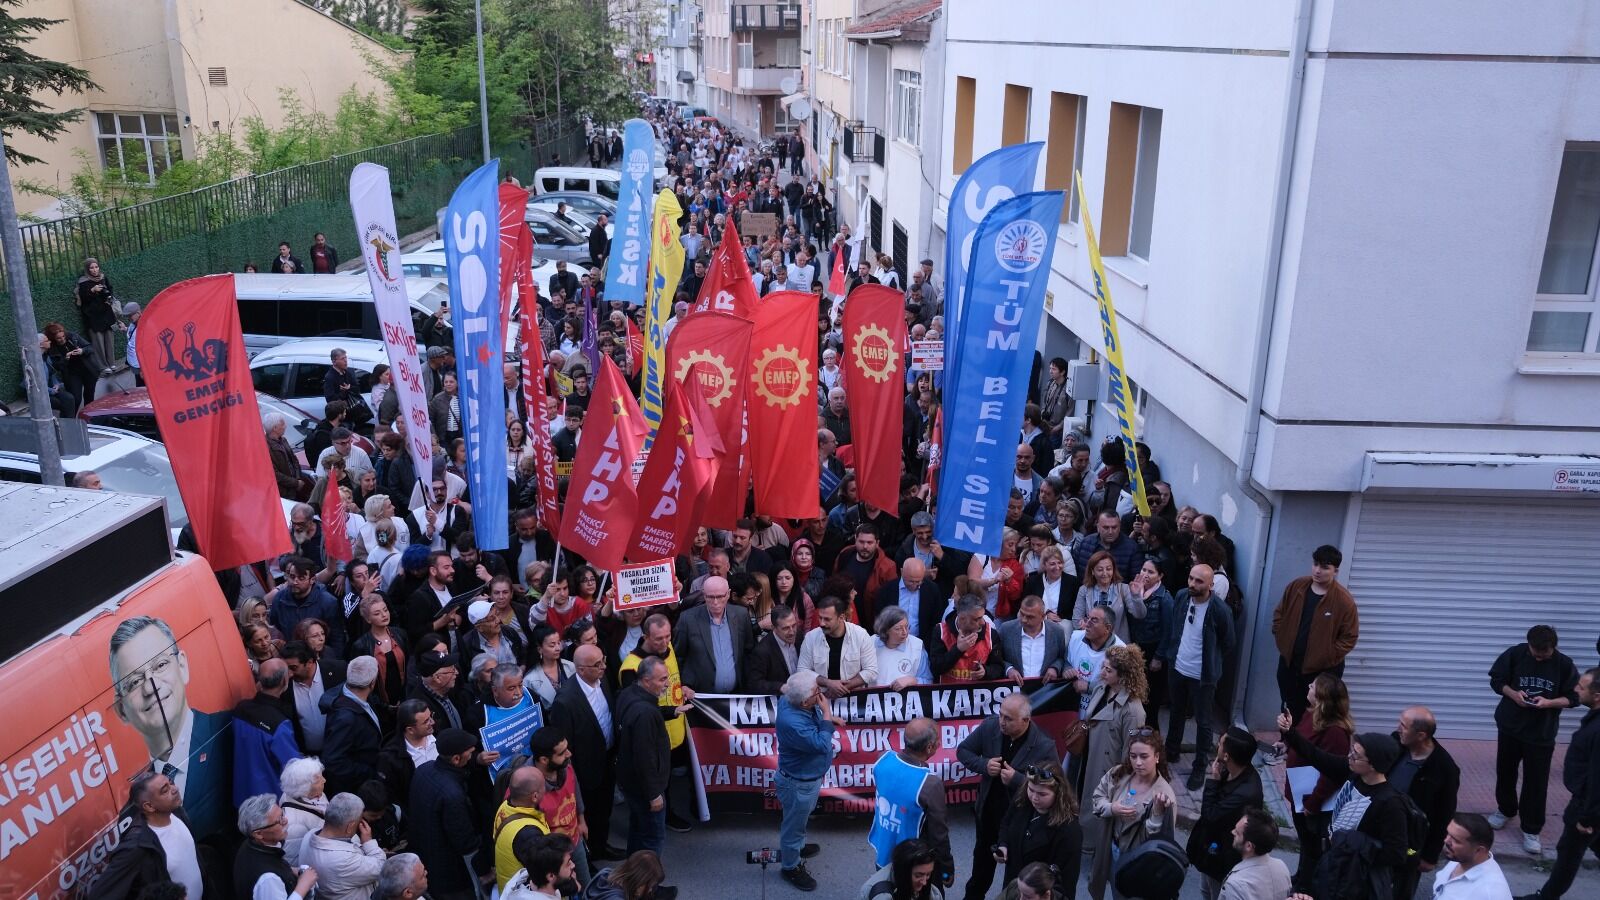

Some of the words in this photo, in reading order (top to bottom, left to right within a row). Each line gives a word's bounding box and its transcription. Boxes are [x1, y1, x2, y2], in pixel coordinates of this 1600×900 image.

[453, 209, 488, 357] SOL
[986, 279, 1029, 351] TÜM
[697, 371, 723, 389] MEP
[765, 369, 800, 385] EMEP
[574, 527, 600, 547] PARTİSİ
[644, 525, 675, 540] EMEKÇİ
[638, 541, 670, 556] PARTİSİ
[621, 569, 650, 578] YASAKLAR
[630, 575, 660, 586] MÜCADELE
[1520, 676, 1554, 691] NIKE
[846, 728, 892, 753] YOK
[701, 764, 731, 786] YA
[736, 765, 776, 788] HEP
[876, 791, 902, 825] OL
